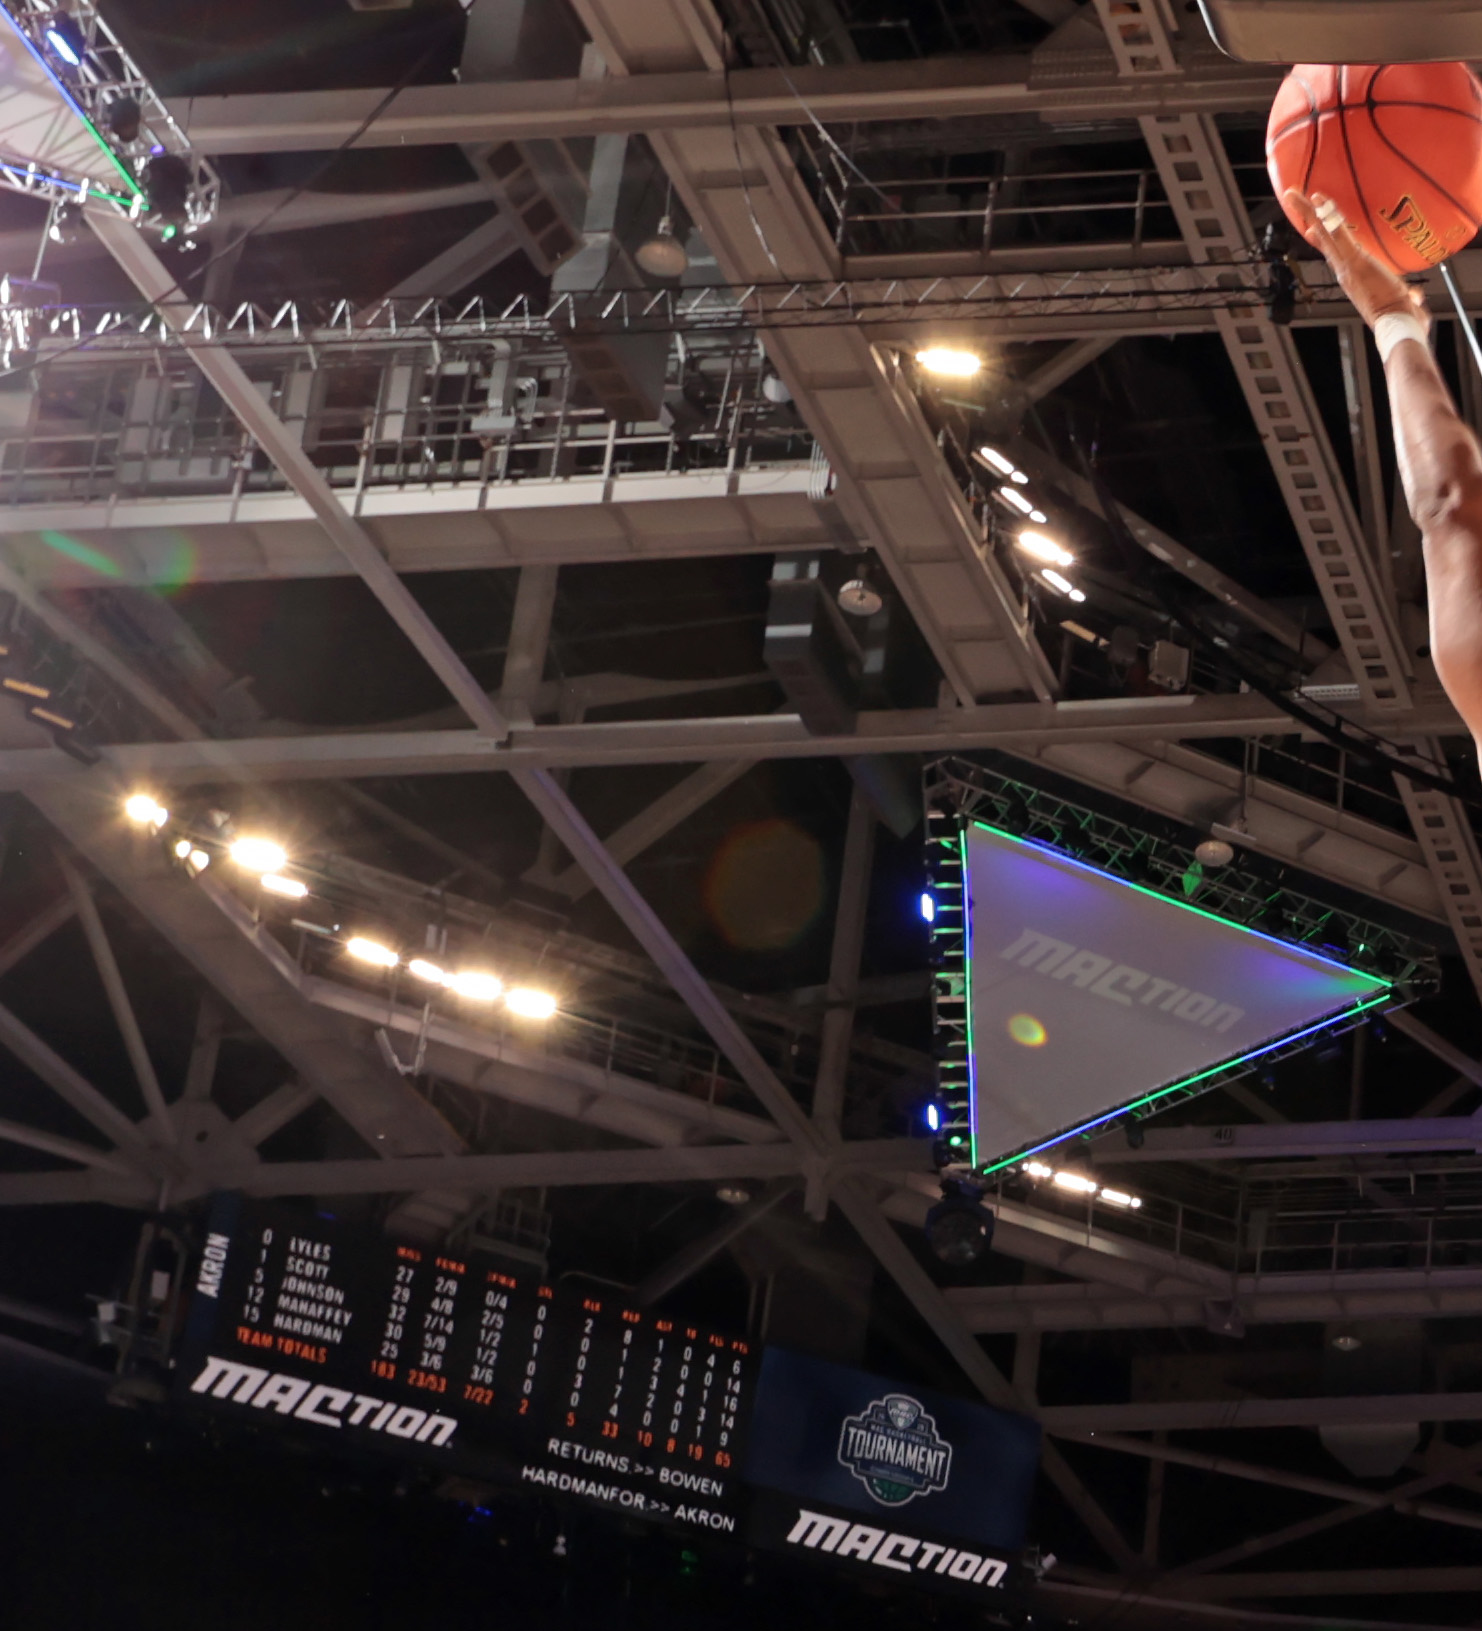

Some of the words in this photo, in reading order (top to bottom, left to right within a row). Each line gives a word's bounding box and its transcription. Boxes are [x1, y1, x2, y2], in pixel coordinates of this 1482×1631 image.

[998, 927, 1246, 1033] MACTION
[196, 1232, 230, 1298] AKRON
[285, 1256, 330, 1279] SCOTT
[290, 1236, 330, 1260] LYLES
[277, 1294, 352, 1326] MAHAFFEY
[282, 1276, 344, 1304] JOHNSON
[237, 1325, 273, 1348] TEAM
[277, 1336, 327, 1364] TOTALS
[273, 1313, 342, 1343] HARDMAN
[190, 1355, 458, 1447] MACTION
[548, 1437, 630, 1474] RETURNS
[659, 1467, 724, 1497] BOWEN
[847, 1426, 946, 1482] TOURNAMENT
[521, 1465, 645, 1511] HARDMANFOR
[674, 1504, 736, 1532] AKRON
[787, 1508, 1006, 1586] MACTION
